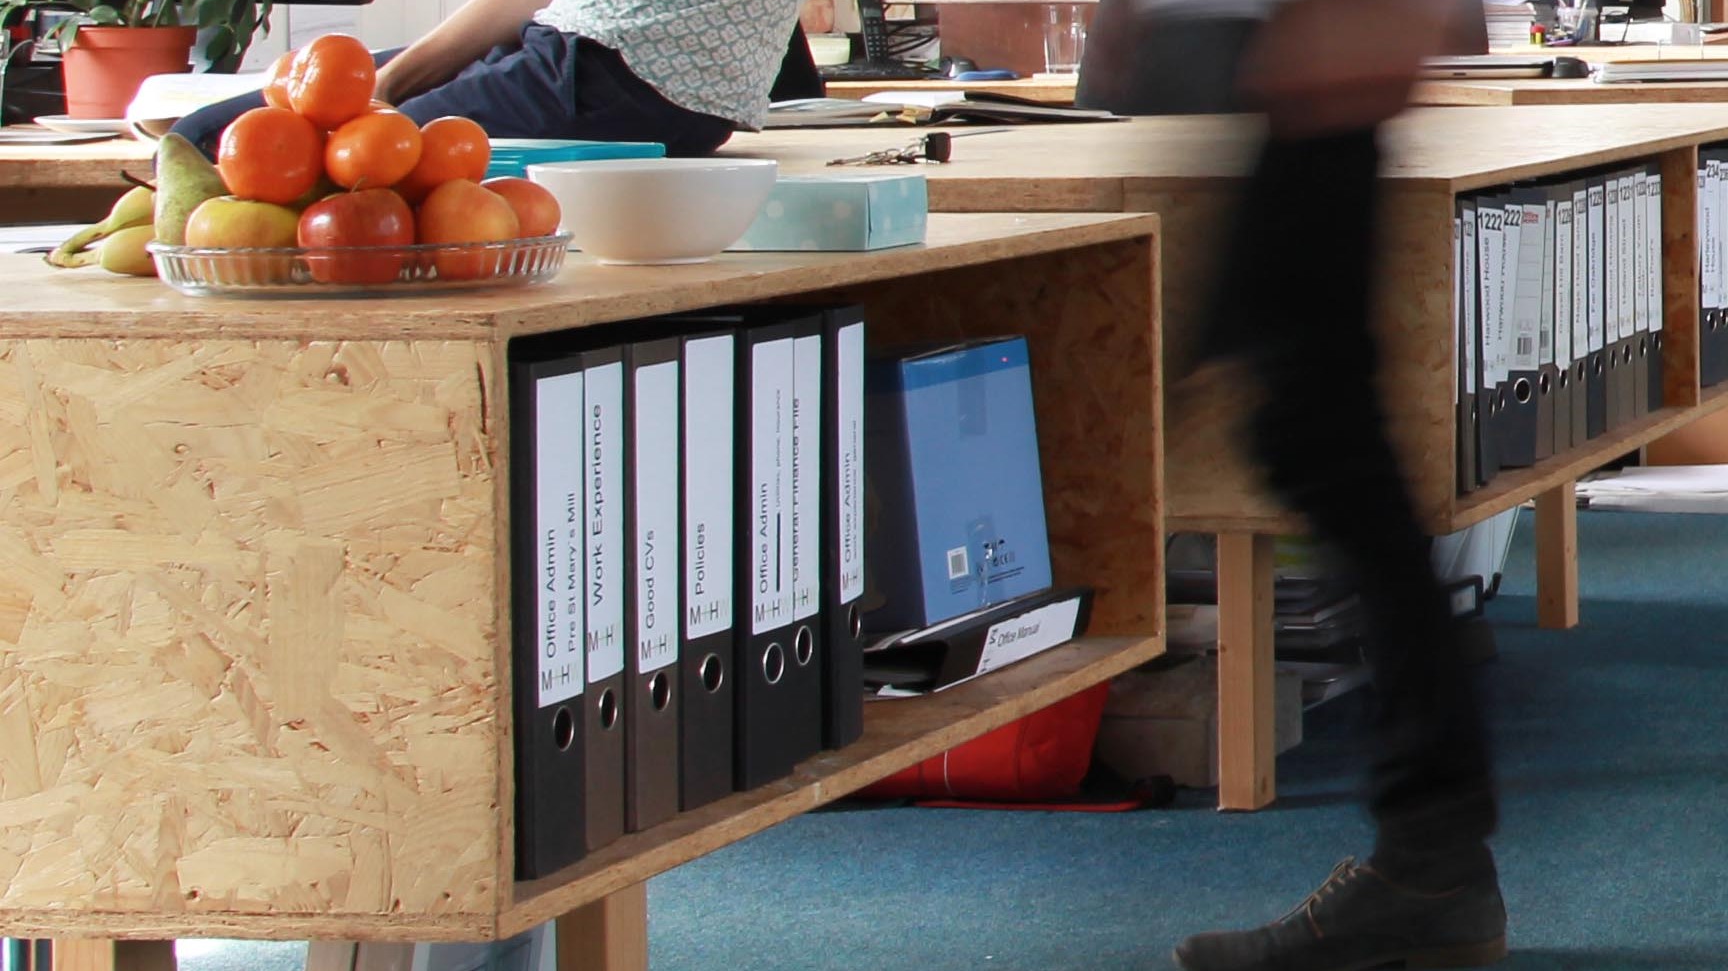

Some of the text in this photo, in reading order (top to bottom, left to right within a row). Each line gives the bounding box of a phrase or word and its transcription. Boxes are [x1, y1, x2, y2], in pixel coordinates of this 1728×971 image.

[1478, 211, 1502, 232] 1222
[1504, 209, 1521, 227] 222
[567, 492, 576, 523] Mill
[592, 404, 605, 606] Work Experience
[760, 483, 768, 594] Office Admin
[695, 523, 705, 595] Policies
[546, 529, 557, 659] Office Admin
[645, 530, 655, 629] Good CVs
[568, 596, 576, 614] St
[568, 621, 576, 653] Pre
[998, 620, 1041, 647] Office Manual
